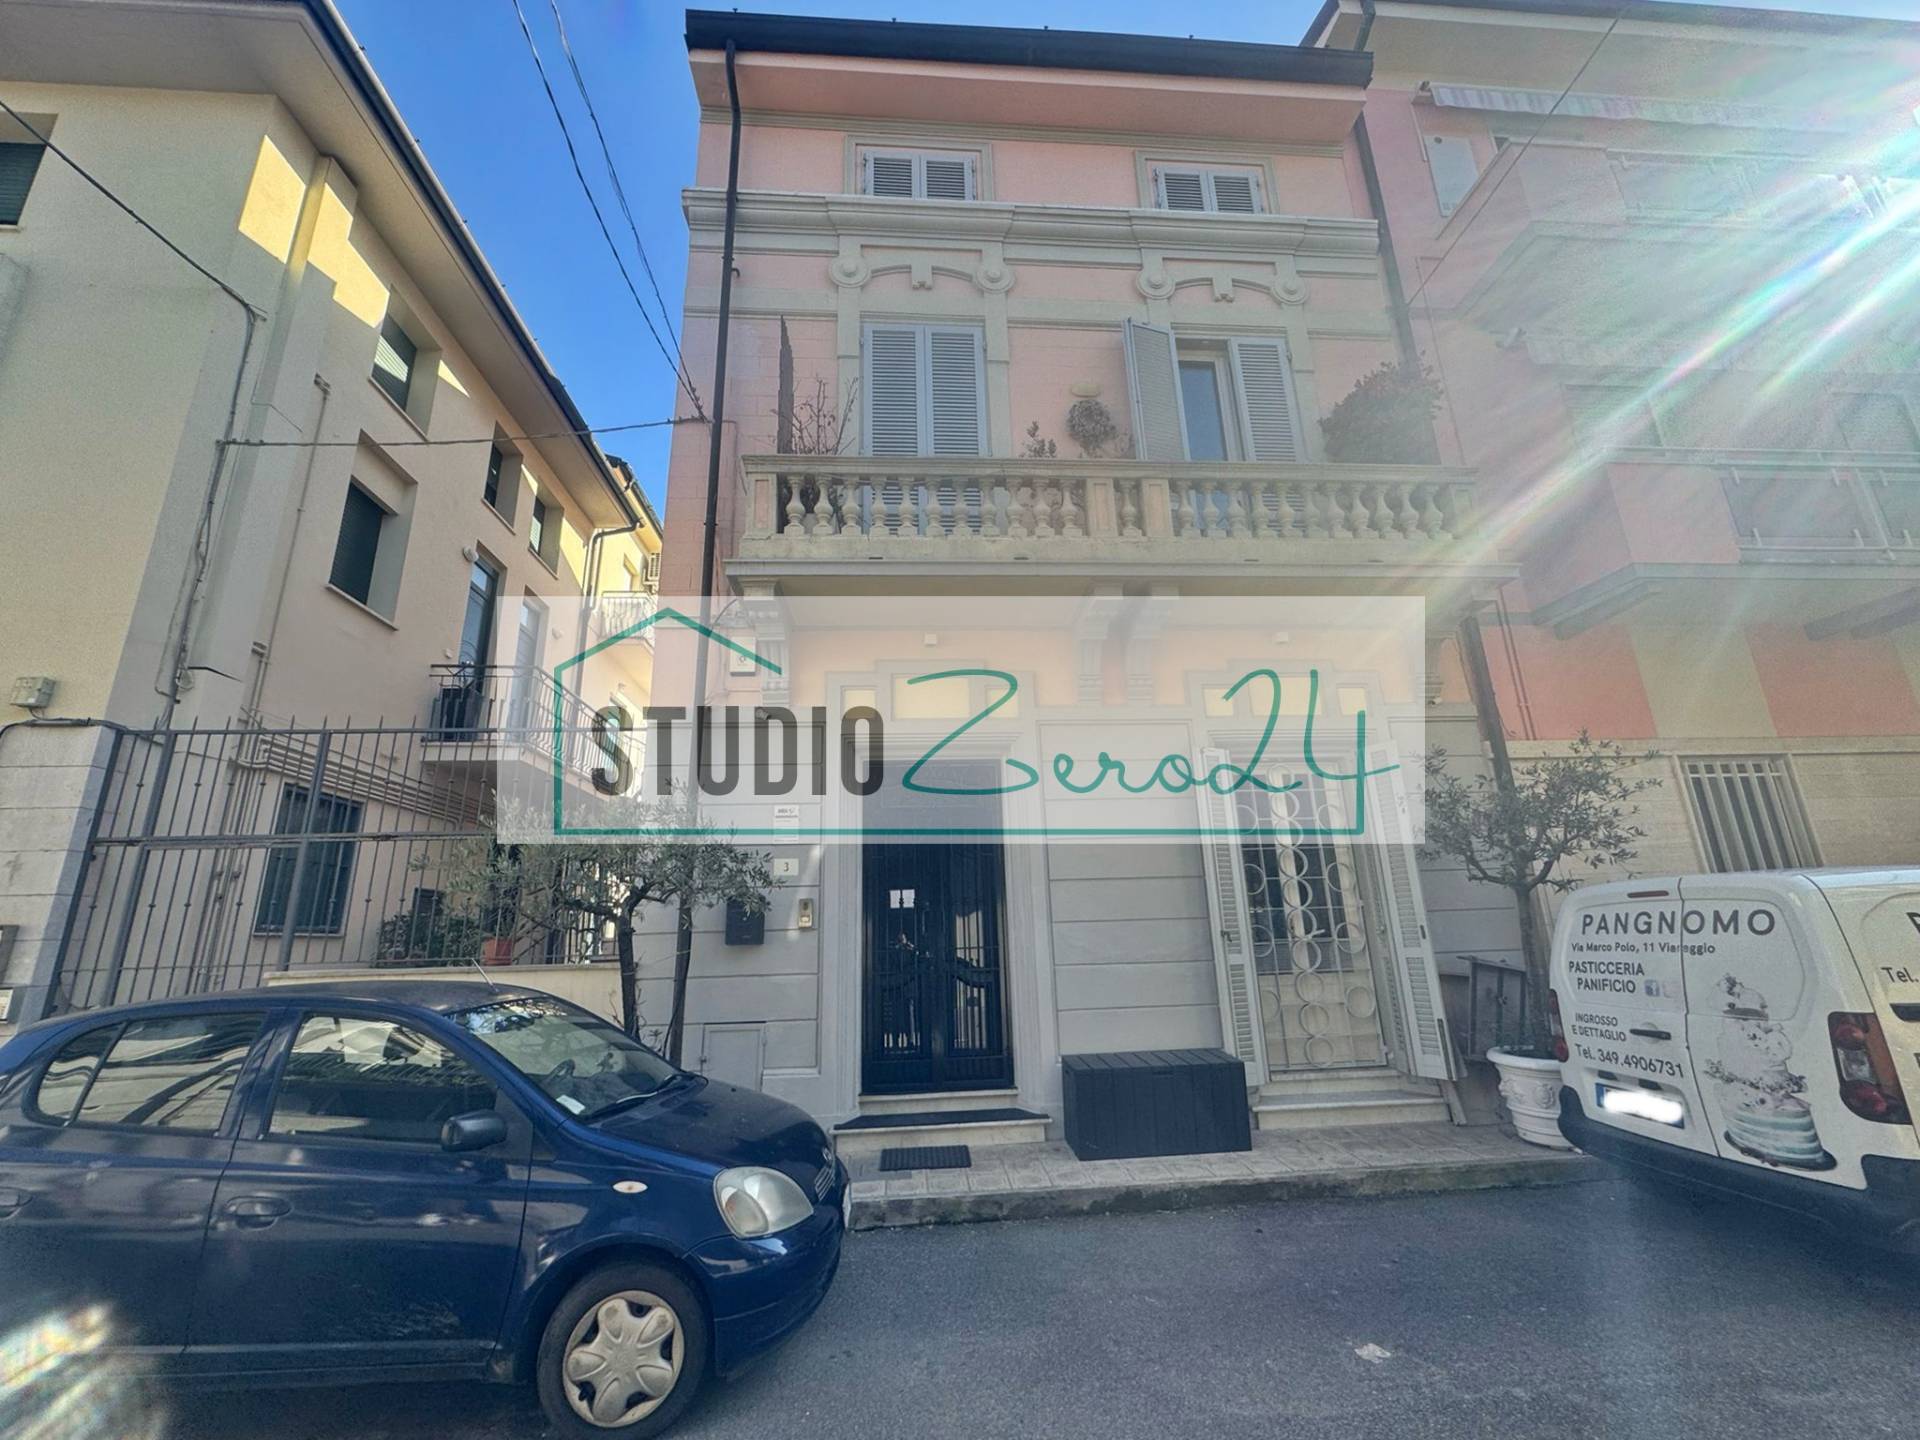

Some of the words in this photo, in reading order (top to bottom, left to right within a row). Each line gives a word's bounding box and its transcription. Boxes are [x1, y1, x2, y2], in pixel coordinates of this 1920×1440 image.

[783, 862, 789, 872] 3
[1582, 909, 1775, 935] PANGNOMO
[1571, 943, 1584, 952] Via
[1586, 943, 1612, 952] Marco
[1643, 943, 1654, 952] 11
[1569, 961, 1645, 976] PASTICCERIA
[1881, 967, 1919, 983] Tel.
[1577, 978, 1636, 993] PANIFICIO
[1575, 1013, 1618, 1027] INGROSSO
[1571, 1025, 1578, 1035] E
[1579, 1026, 1627, 1042] DETTAGLIO
[1575, 1043, 1596, 1060] Tel.
[1598, 1048, 1684, 1078] 349.4906731
